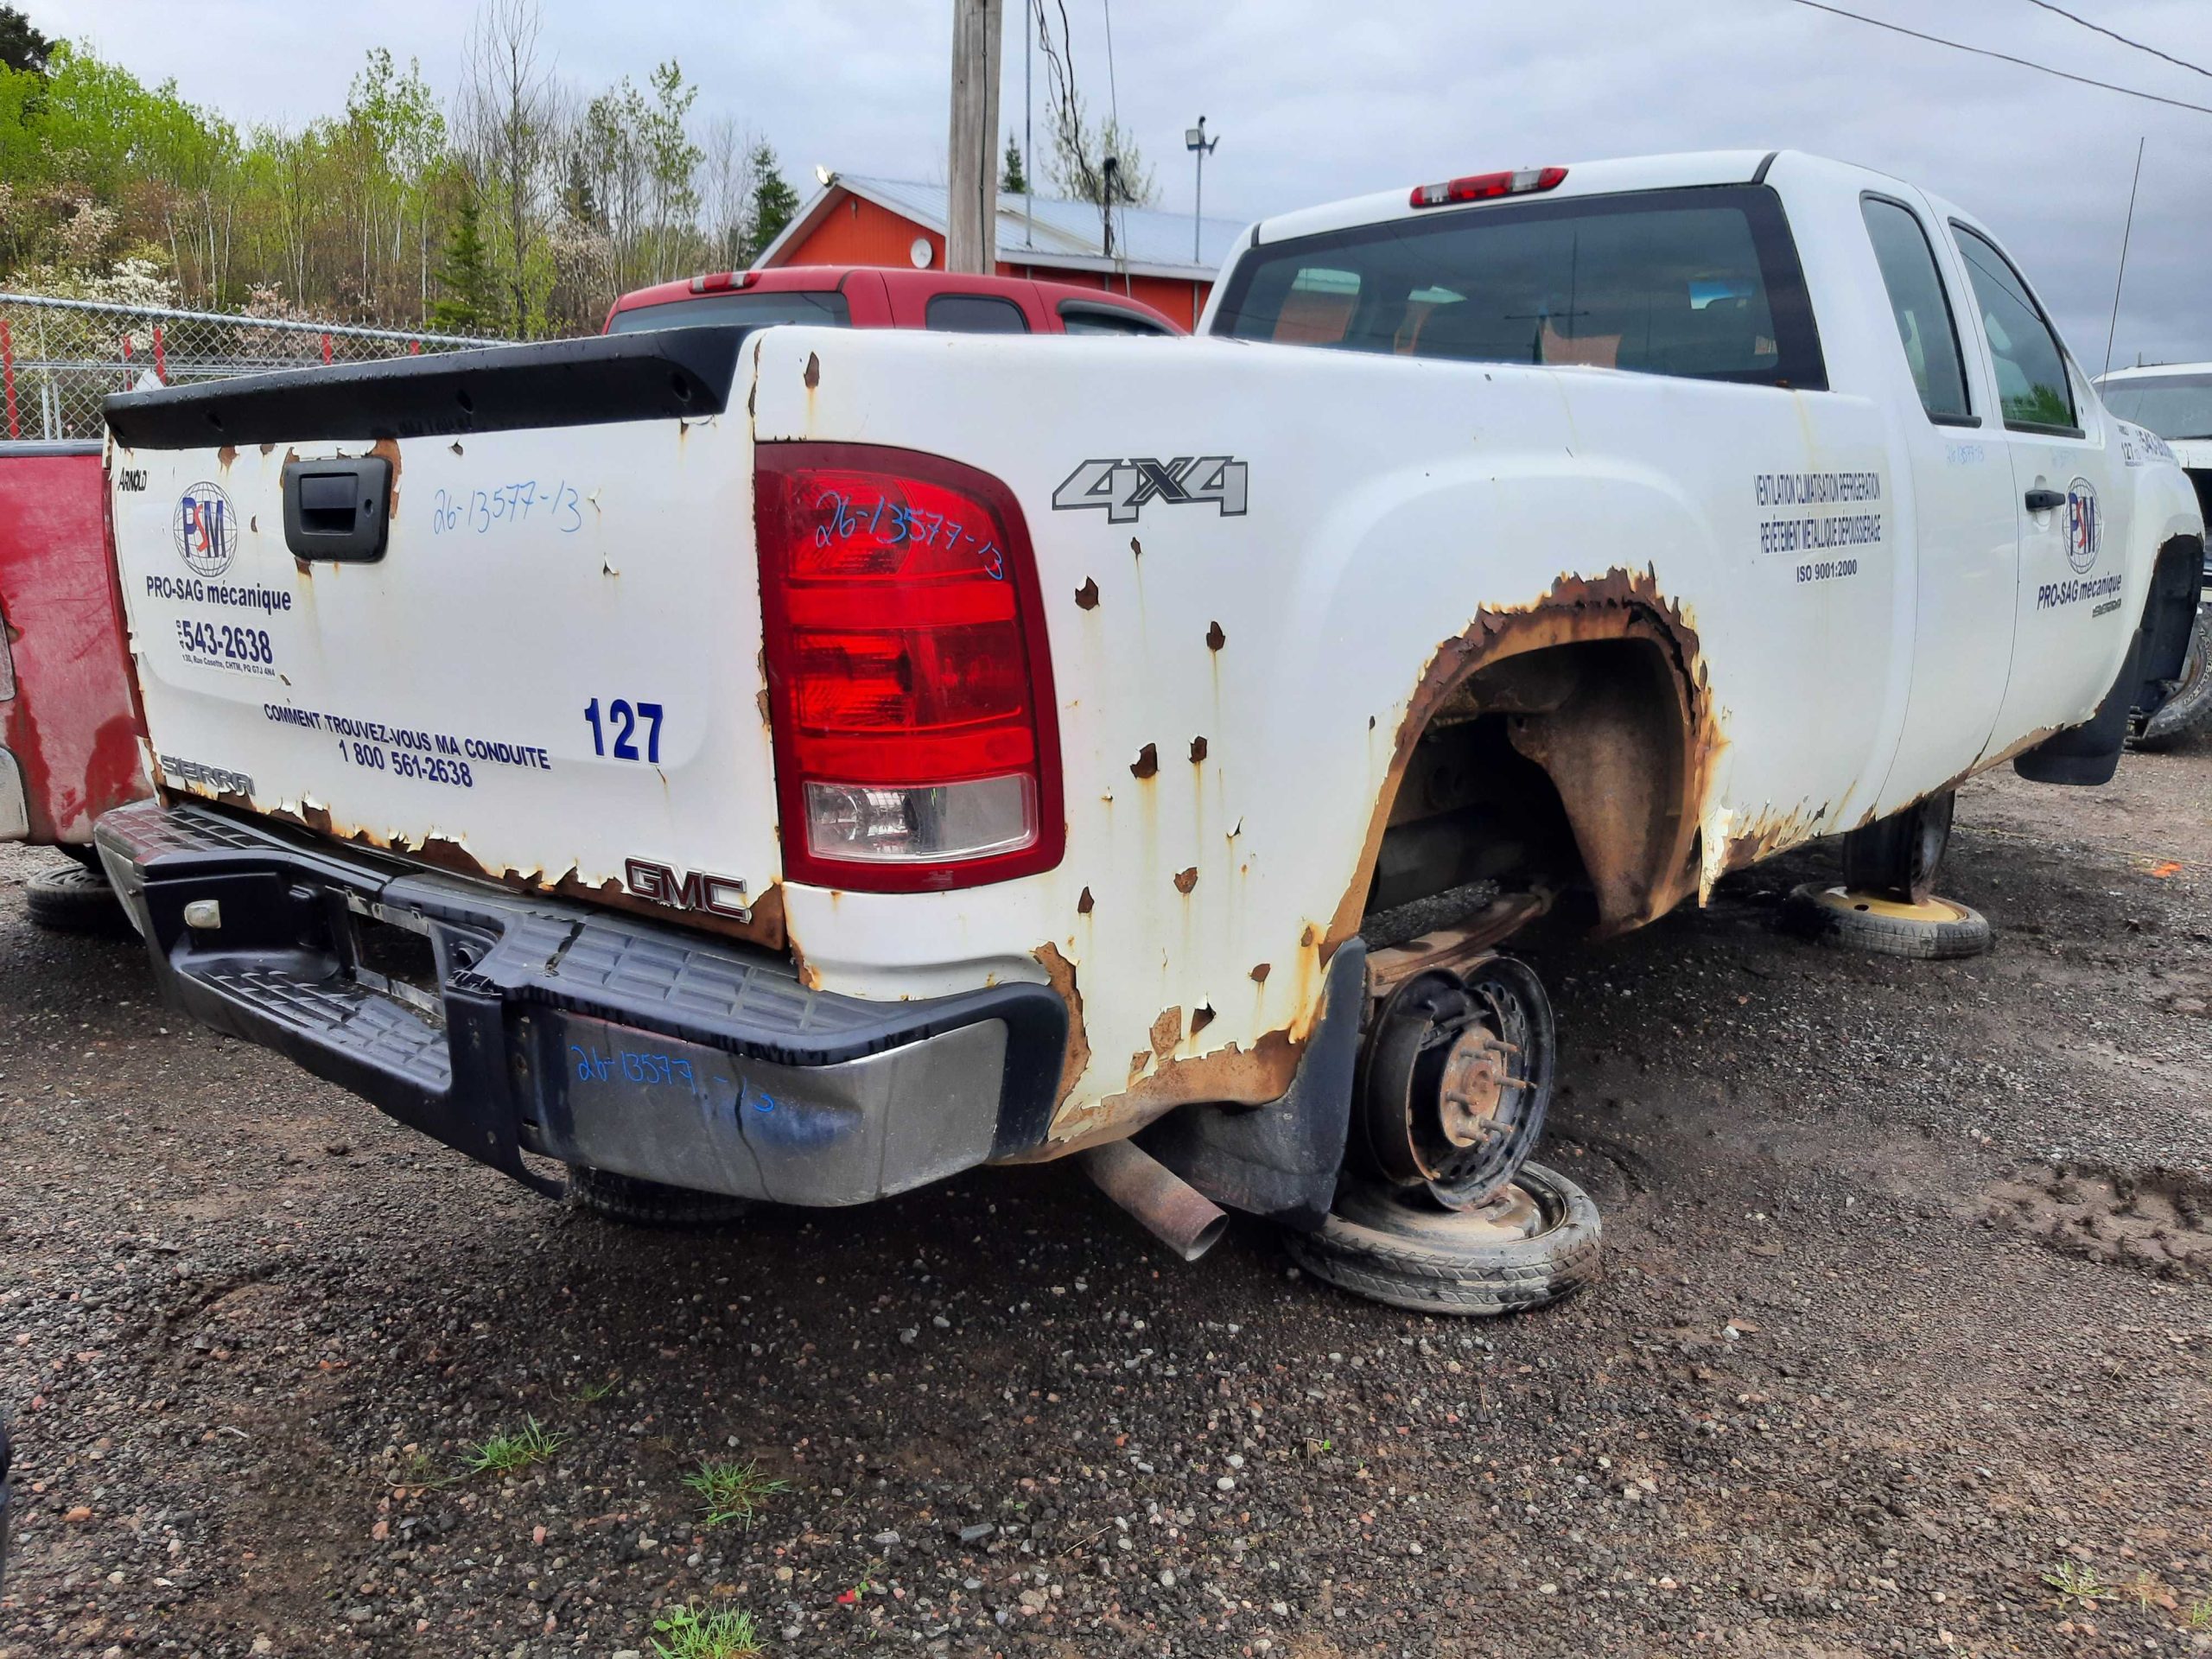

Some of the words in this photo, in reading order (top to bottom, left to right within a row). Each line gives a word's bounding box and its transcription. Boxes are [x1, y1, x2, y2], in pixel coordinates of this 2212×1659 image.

[2121, 442, 2134, 461] 127
[434, 480, 582, 535] 26-13577-13
[1753, 474, 1796, 506] VENTILATION
[1796, 474, 1840, 505] CLIMATISATION
[182, 497, 227, 559] PSM
[815, 489, 1003, 582] 26-13577-13
[2069, 493, 2095, 556] PSM
[146, 575, 204, 602] PRO-SAG
[207, 580, 291, 616] mécanique
[1797, 565, 1813, 583] ISO
[1815, 559, 1858, 581] 9001:2000
[2037, 579, 2079, 611] PRO-SAG
[2078, 571, 2122, 600] mécanique
[181, 620, 273, 664] 543-2638
[264, 702, 321, 731] COMMENT
[324, 714, 432, 752] TROUVEZ-VOUS
[435, 734, 461, 757] MA
[464, 737, 551, 771] CONDUITE
[584, 697, 664, 764] 127
[160, 753, 257, 798] SIERRA
[338, 739, 349, 763] 1
[354, 741, 385, 771] 800
[391, 750, 474, 788] 561-2638
[624, 855, 752, 924] GMC
